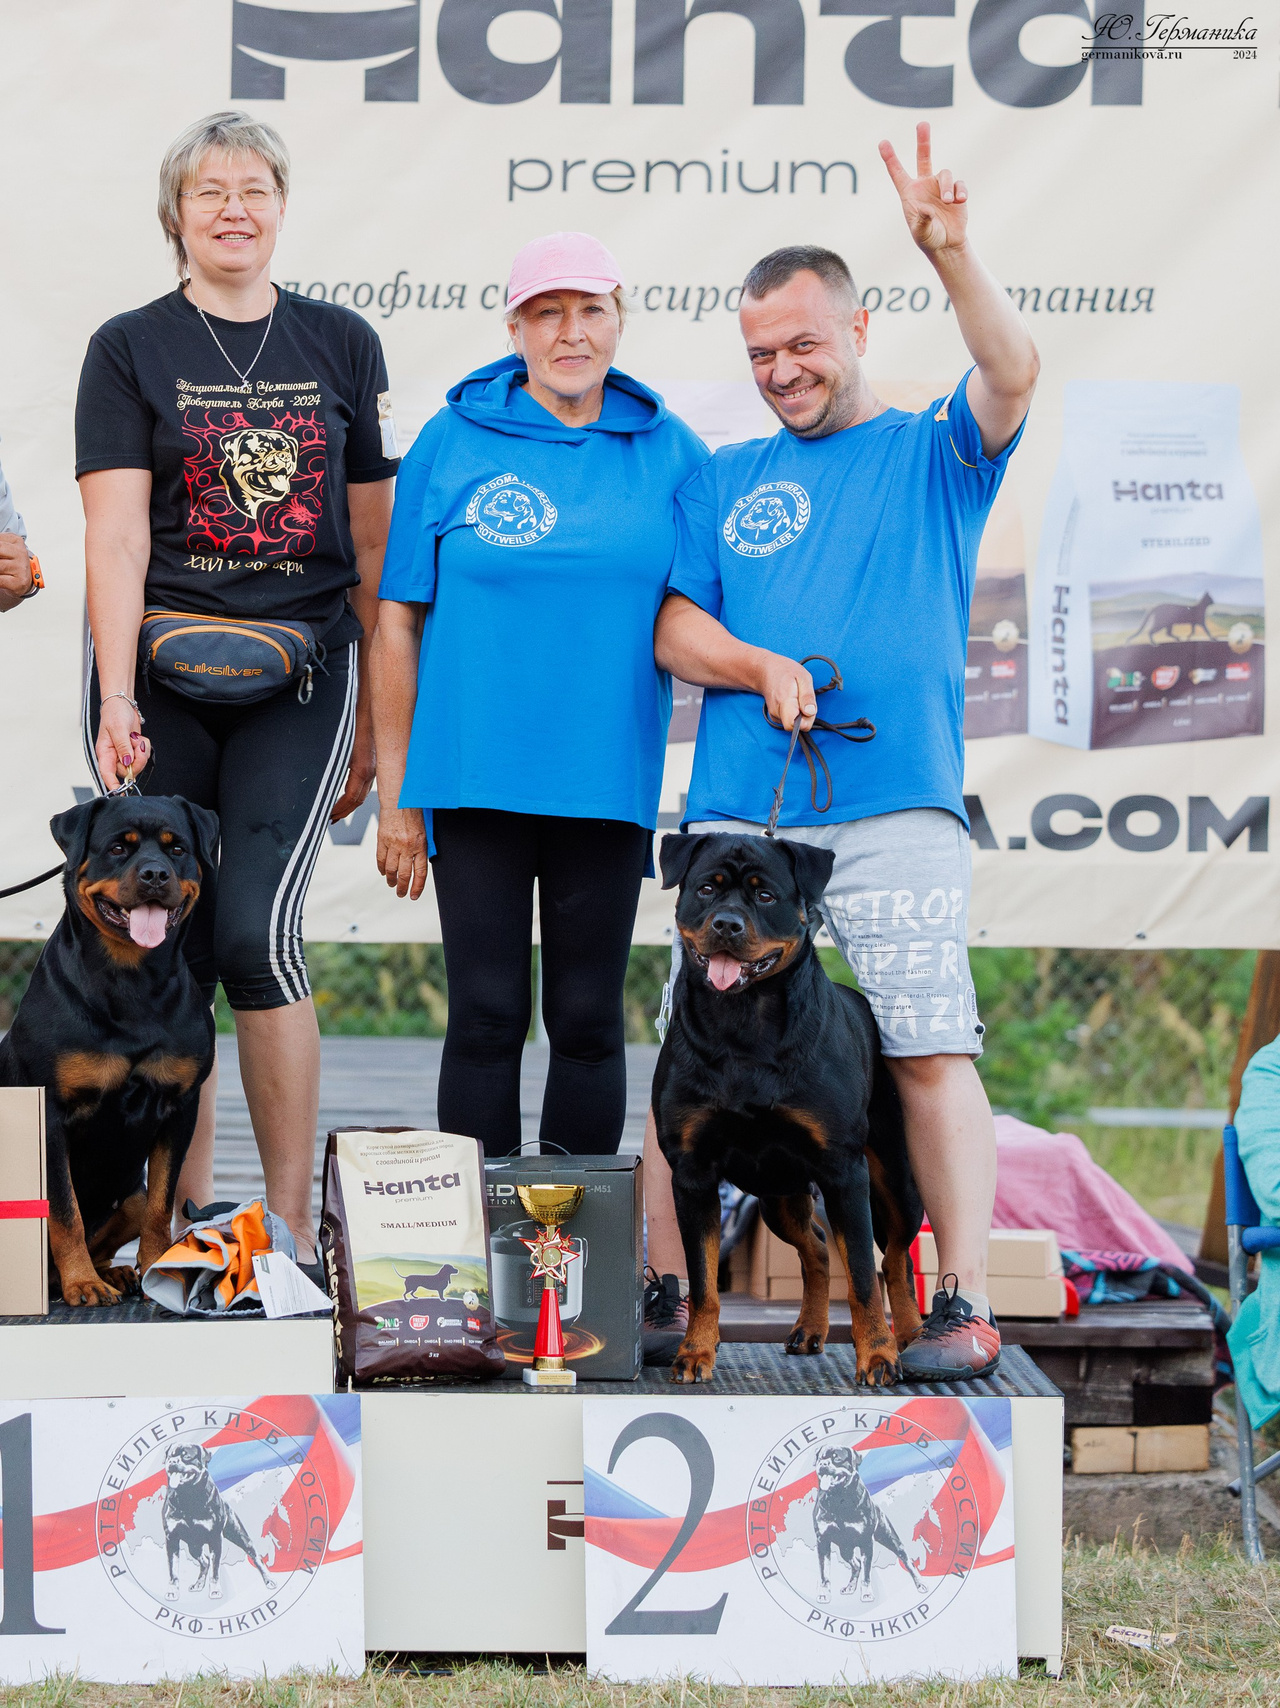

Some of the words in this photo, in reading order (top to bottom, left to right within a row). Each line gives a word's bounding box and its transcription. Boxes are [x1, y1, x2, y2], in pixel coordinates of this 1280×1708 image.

[508, 147, 858, 202] premium
[256, 380, 318, 396] Чемпионат
[176, 393, 242, 410] Победитель
[246, 397, 284, 411] Клуба
[488, 475, 519, 489] DOMA
[745, 484, 773, 503] DOMA
[775, 483, 803, 498] TORRA
[1113, 480, 1224, 501] Hanta
[477, 523, 539, 545] ROTTWEILER
[736, 532, 794, 555] ROTTWEILER
[183, 554, 224, 572] XXVI
[1051, 585, 1070, 727] Hanta
[174, 661, 263, 677] QUIKSILVER
[380, 1157, 414, 1165] говядиной
[364, 1173, 461, 1195] Hanta
[381, 1220, 457, 1229] SMALL/MEDIUM
[99, 1415, 185, 1578] РОТВЕЙЛЕР
[203, 1410, 281, 1446] КЛУБ
[287, 1452, 326, 1576] РОССИИ
[750, 1417, 836, 1580] РОТВЕЙЛЕР
[854, 1412, 931, 1450] КЛУБ
[938, 1455, 977, 1581] РОССИИ
[605, 1412, 729, 1635] 2
[155, 1599, 280, 1636] РКФ-НКПР
[806, 1601, 932, 1638] РКФ-НКПР
